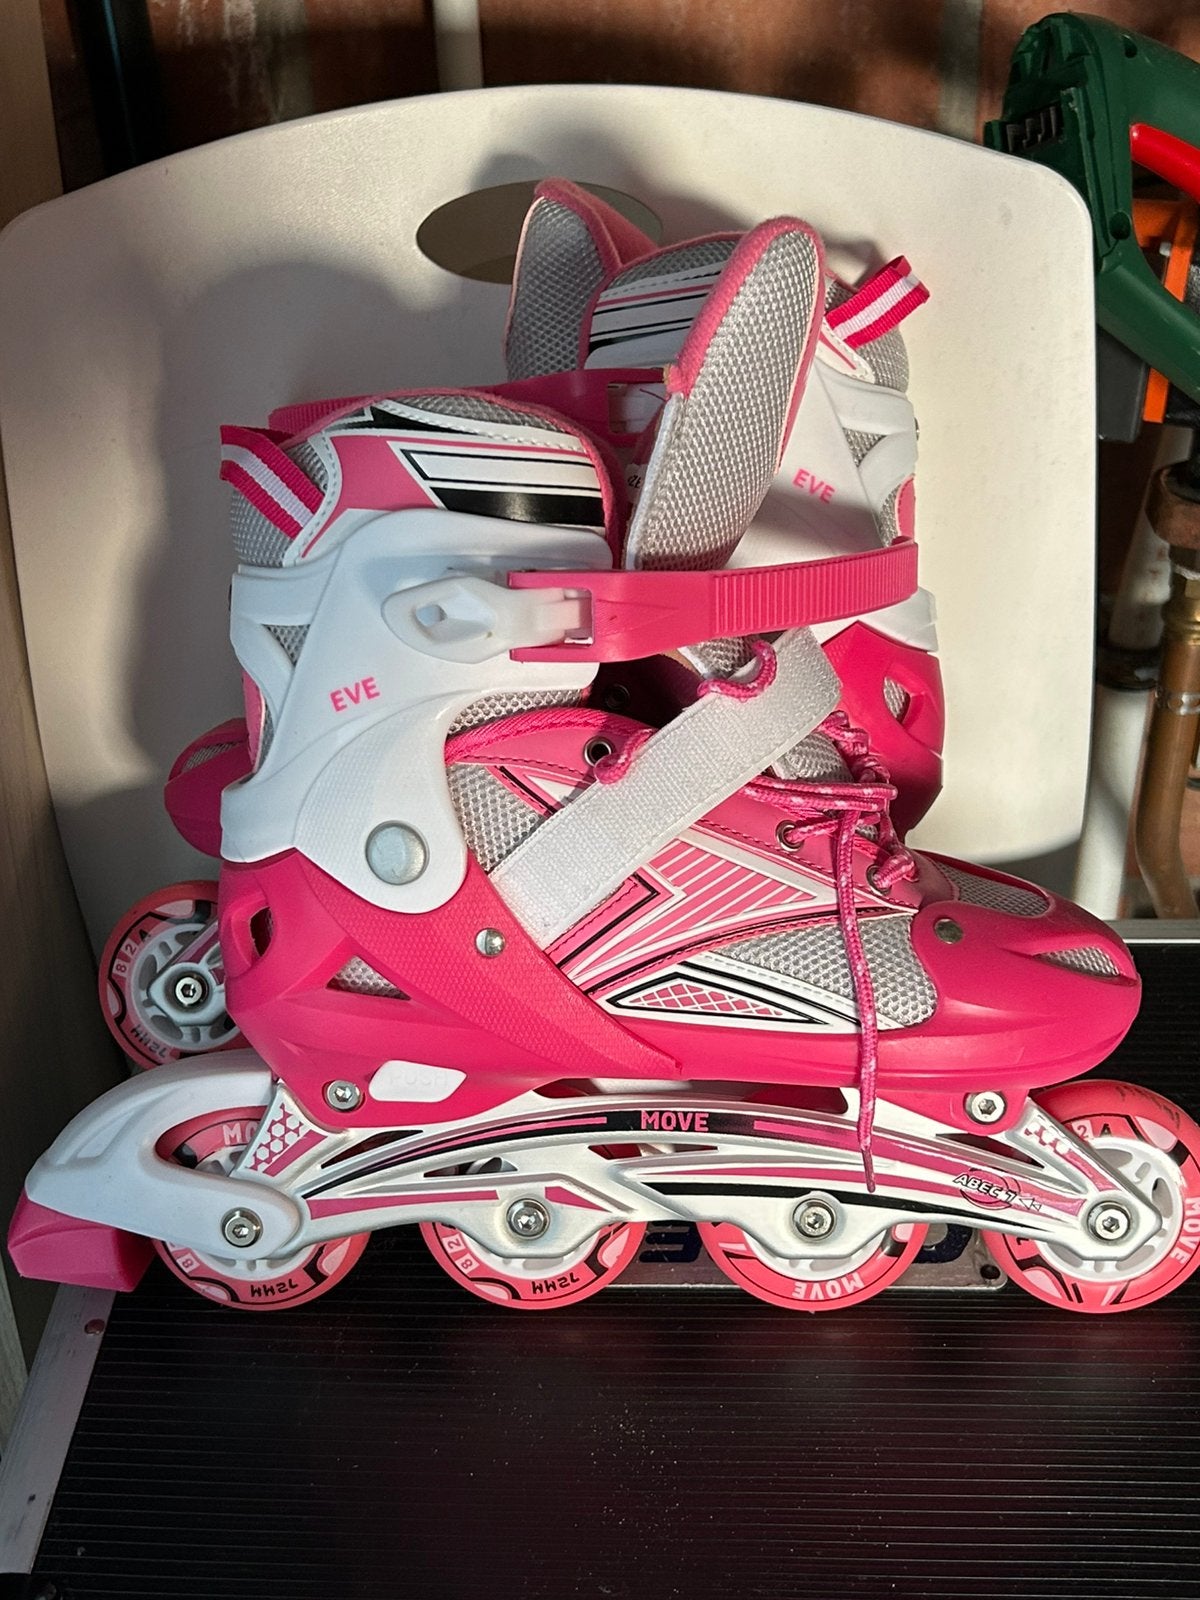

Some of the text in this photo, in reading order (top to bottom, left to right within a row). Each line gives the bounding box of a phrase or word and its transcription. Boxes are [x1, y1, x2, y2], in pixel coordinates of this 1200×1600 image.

[793, 468, 836, 504] EVE
[329, 676, 380, 712] EVE
[222, 1120, 260, 1146] MO
[640, 1109, 710, 1132] MOVE
[952, 1173, 1018, 1204] ABEC 7
[1170, 1196, 1200, 1264] MOVE
[250, 1278, 299, 1298] 72MM
[531, 1271, 580, 1295] 72MM
[792, 1270, 866, 1300] MOVE
